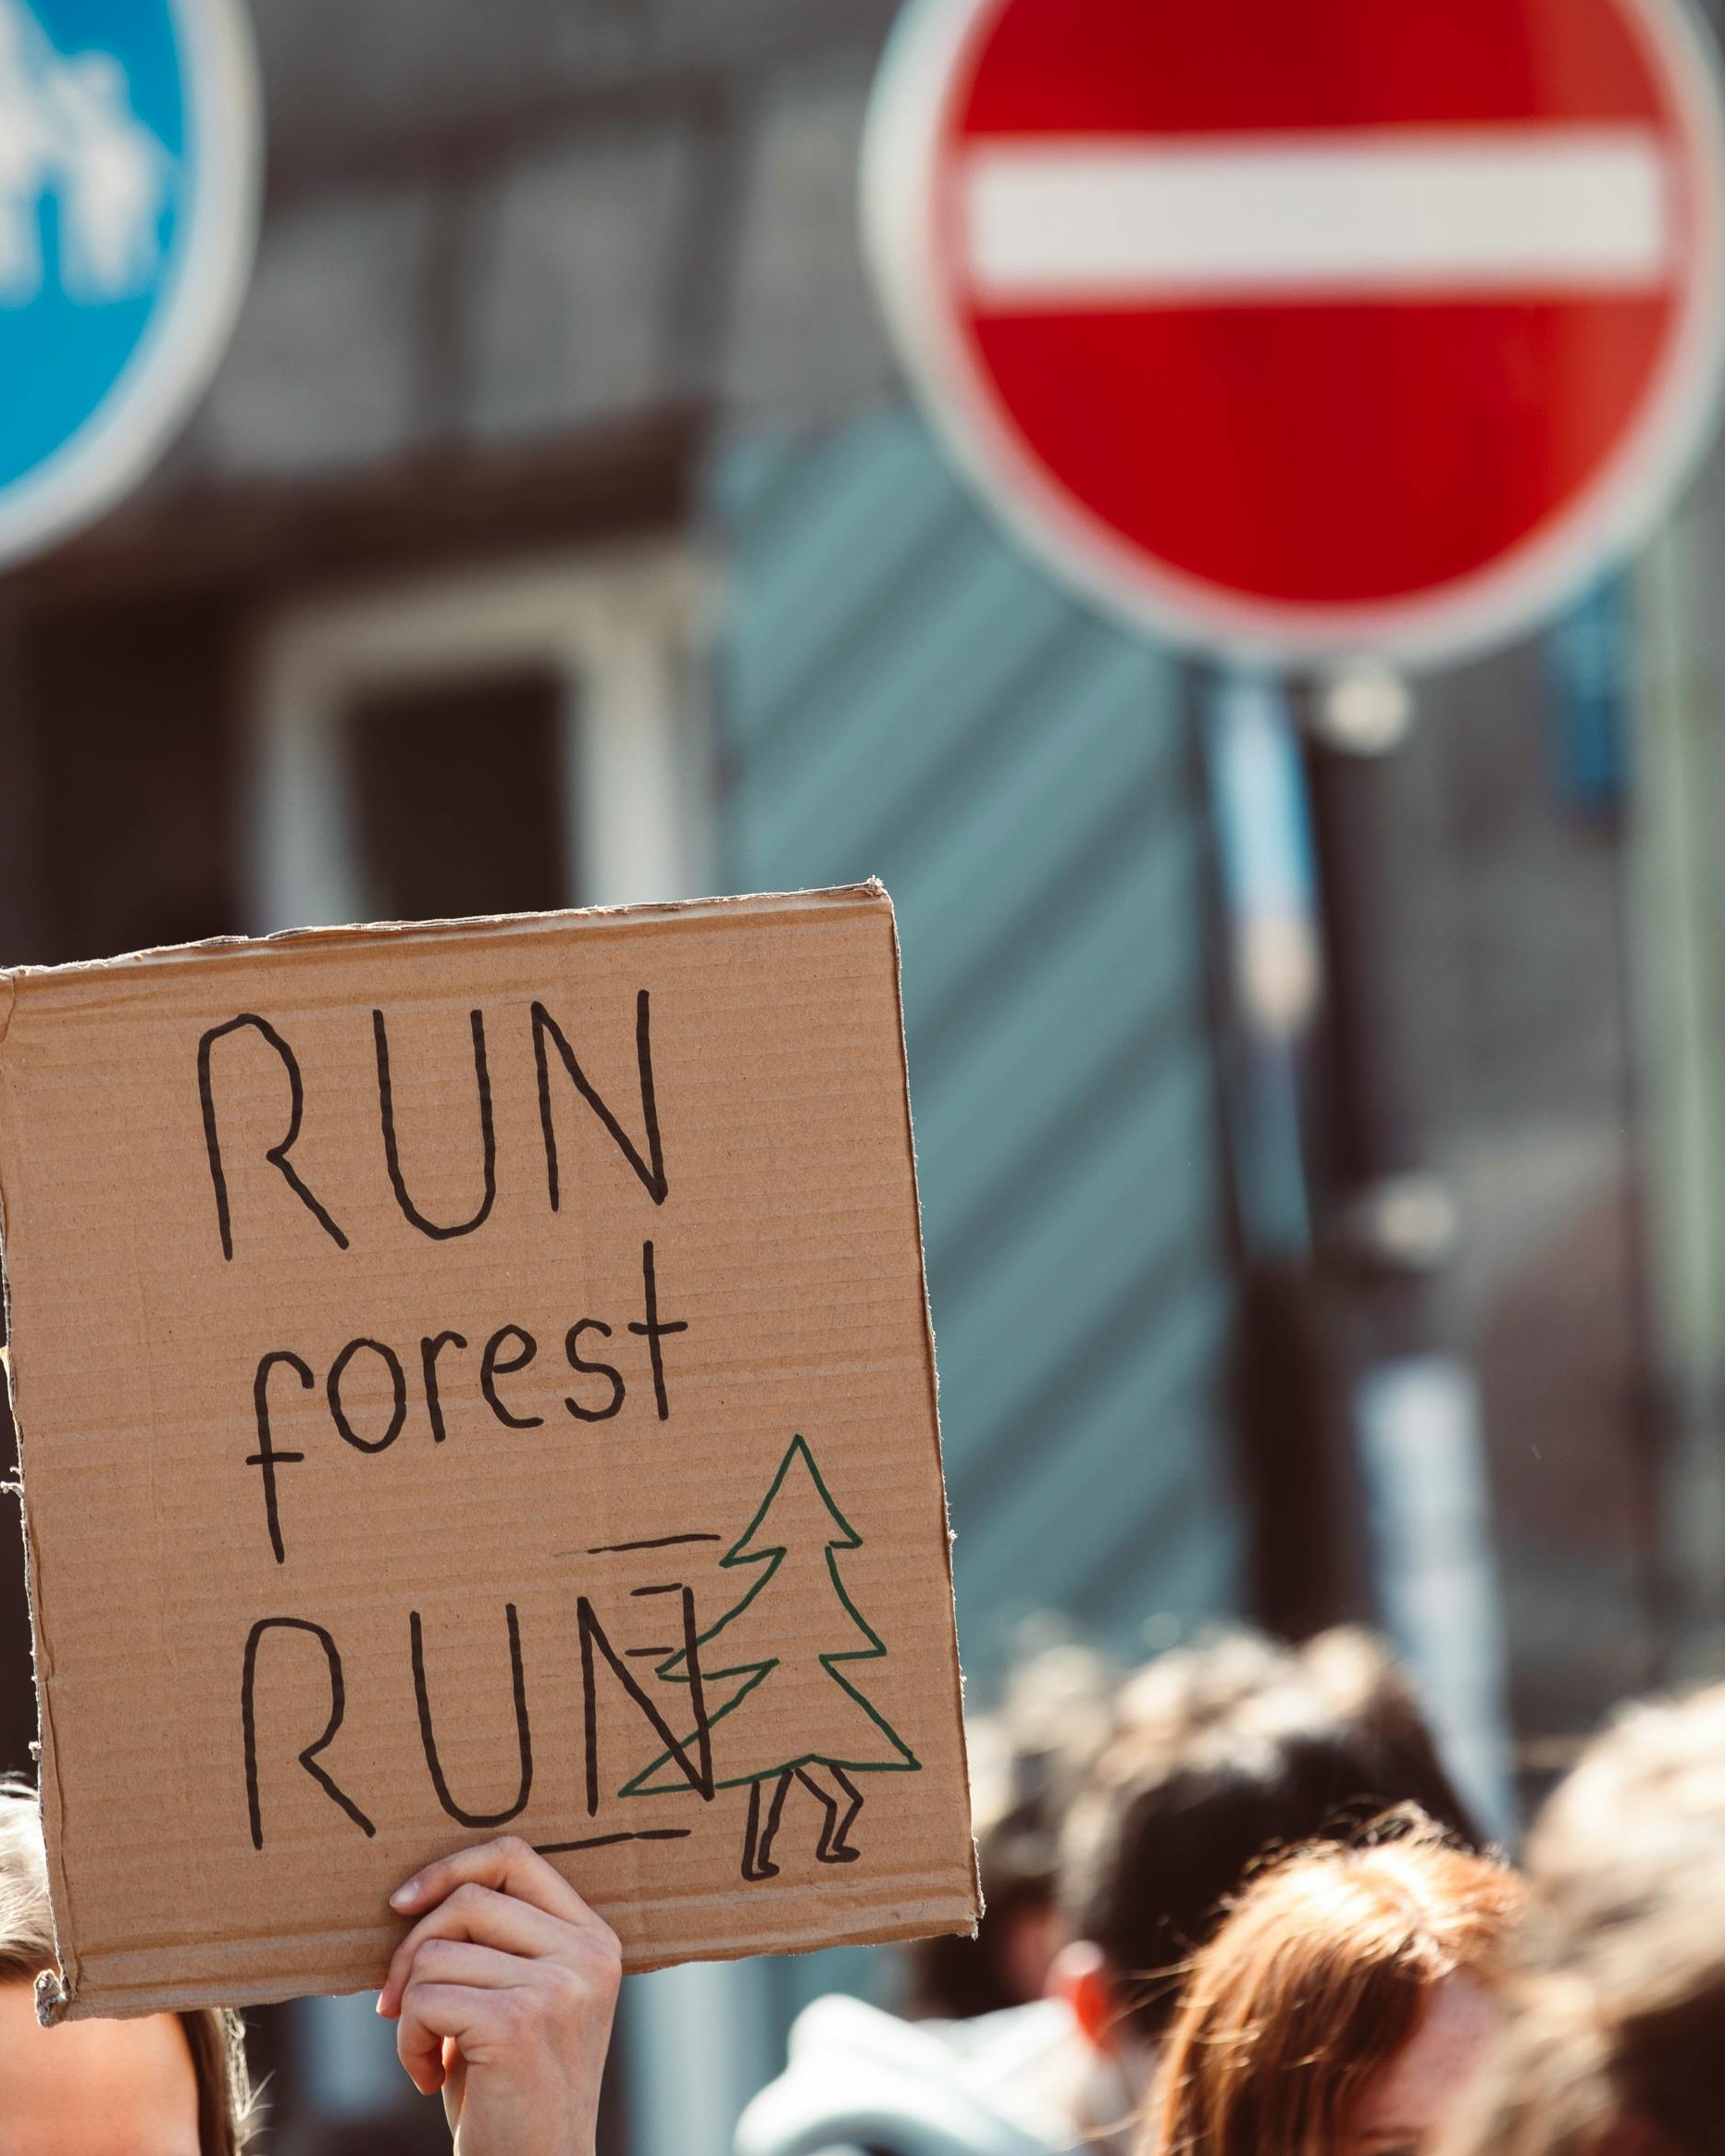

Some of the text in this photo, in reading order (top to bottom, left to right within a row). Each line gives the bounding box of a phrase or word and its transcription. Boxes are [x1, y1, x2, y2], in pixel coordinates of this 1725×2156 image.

[197, 989, 669, 1262] RUN
[245, 1240, 689, 1565] forest
[241, 1585, 715, 1851] RUN
